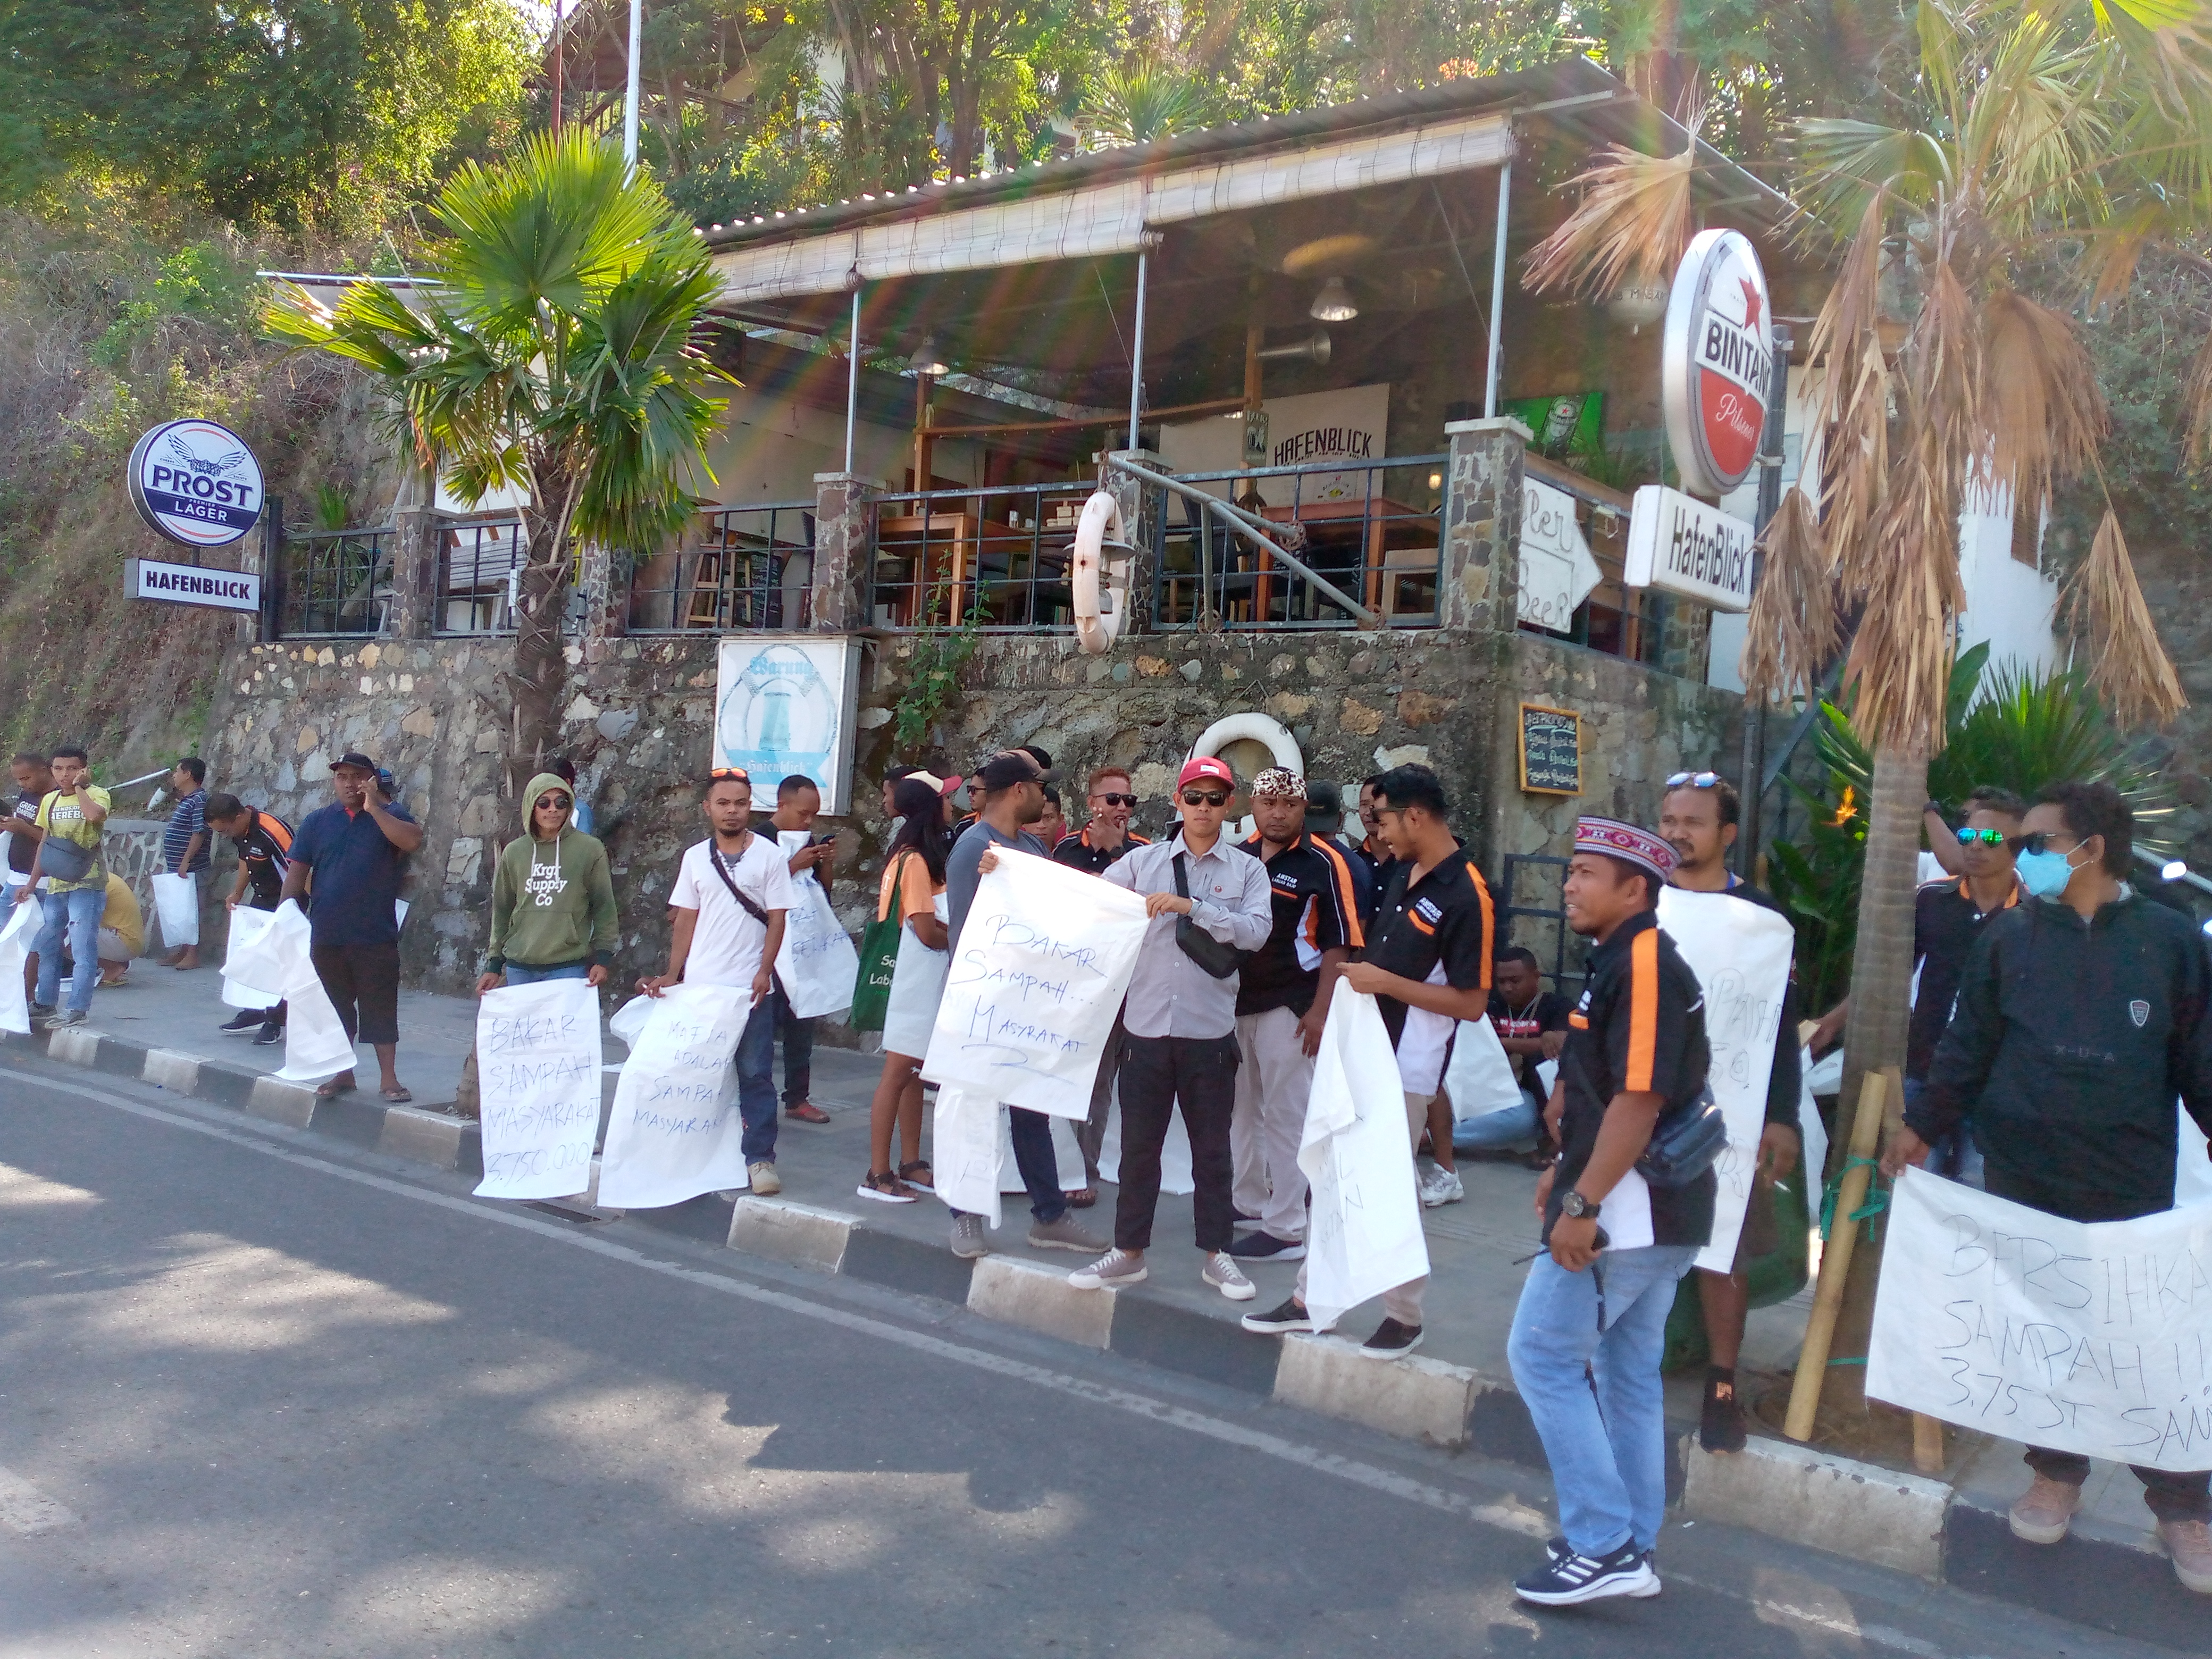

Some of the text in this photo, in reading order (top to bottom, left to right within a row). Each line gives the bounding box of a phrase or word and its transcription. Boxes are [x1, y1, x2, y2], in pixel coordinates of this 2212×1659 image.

[1274, 428, 1372, 466] HAFENBLICK
[151, 464, 254, 507] PROST
[189, 498, 215, 507] PREMIER
[175, 500, 228, 522] LAGER
[1669, 505, 1746, 594] HafenBlick
[146, 571, 250, 600] HAFENBLICK
[525, 878, 568, 893] Supply
[535, 893, 553, 906] Co
[986, 914, 1108, 978] BAKAR
[488, 1015, 577, 1055] BAKAR
[488, 1051, 593, 1098] SAMPAH
[649, 1076, 722, 1103] SAMPA
[488, 1096, 601, 1145] MASYARAKAT
[485, 1142, 590, 1187] 3.750.000
